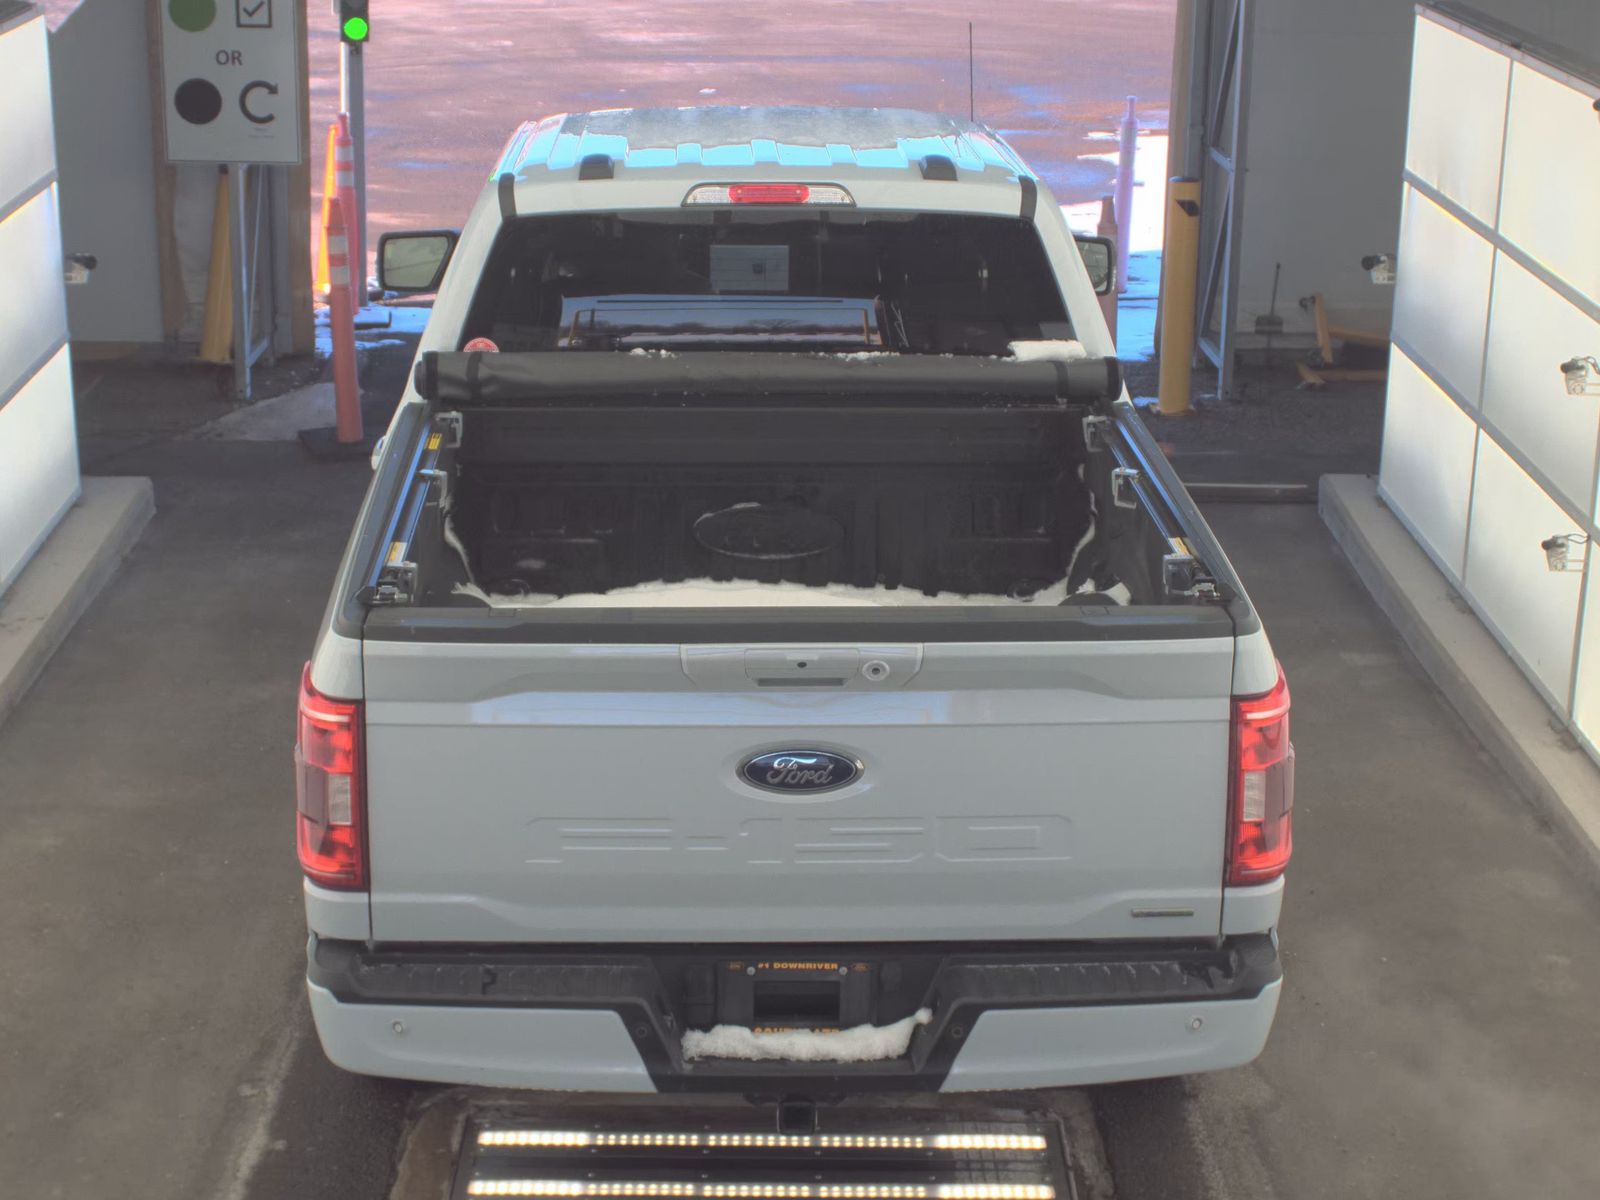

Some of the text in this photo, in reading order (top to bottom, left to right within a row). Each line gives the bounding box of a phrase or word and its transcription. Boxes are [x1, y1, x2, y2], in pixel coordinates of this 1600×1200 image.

[215, 50, 243, 66] OR
[766, 756, 835, 784] Ford
[524, 815, 1073, 865] F-150
[773, 961, 839, 970] DOWNRIVER
